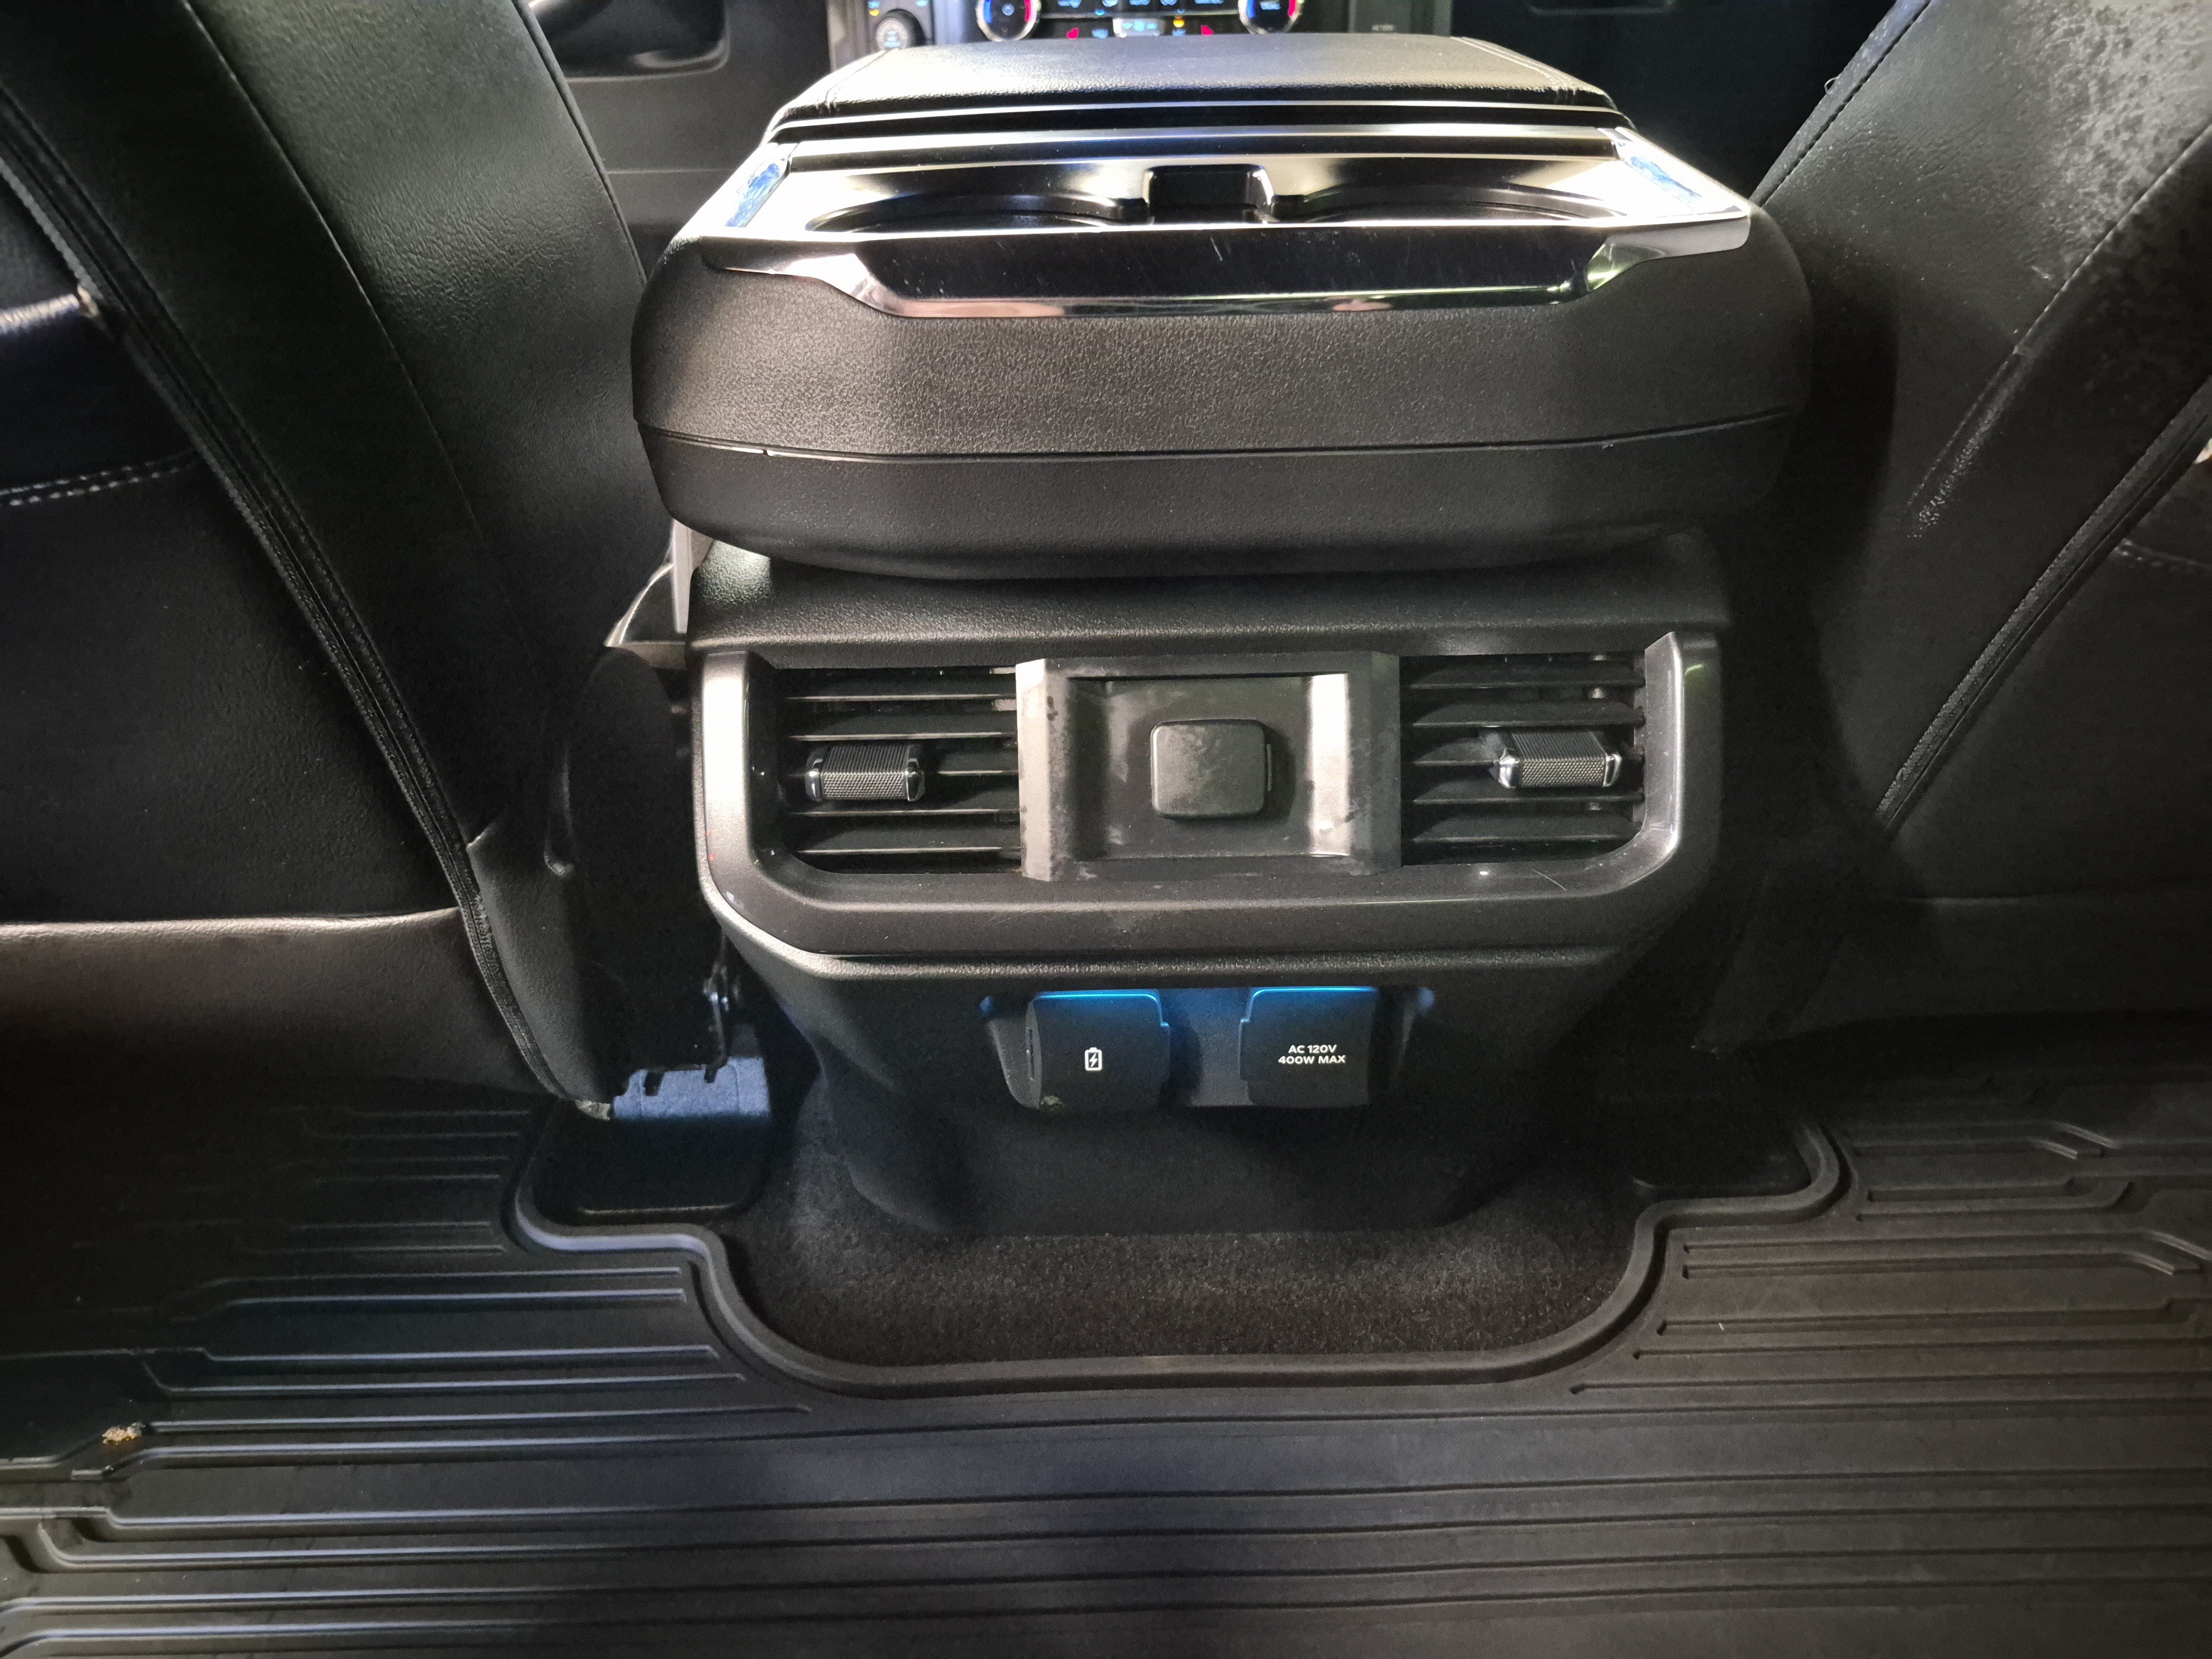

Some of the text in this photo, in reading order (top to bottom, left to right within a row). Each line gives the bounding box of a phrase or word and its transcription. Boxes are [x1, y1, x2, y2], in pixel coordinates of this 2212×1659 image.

[1288, 1044, 1337, 1053] AC 120V
[1278, 1055, 1346, 1064] 400W MAX
